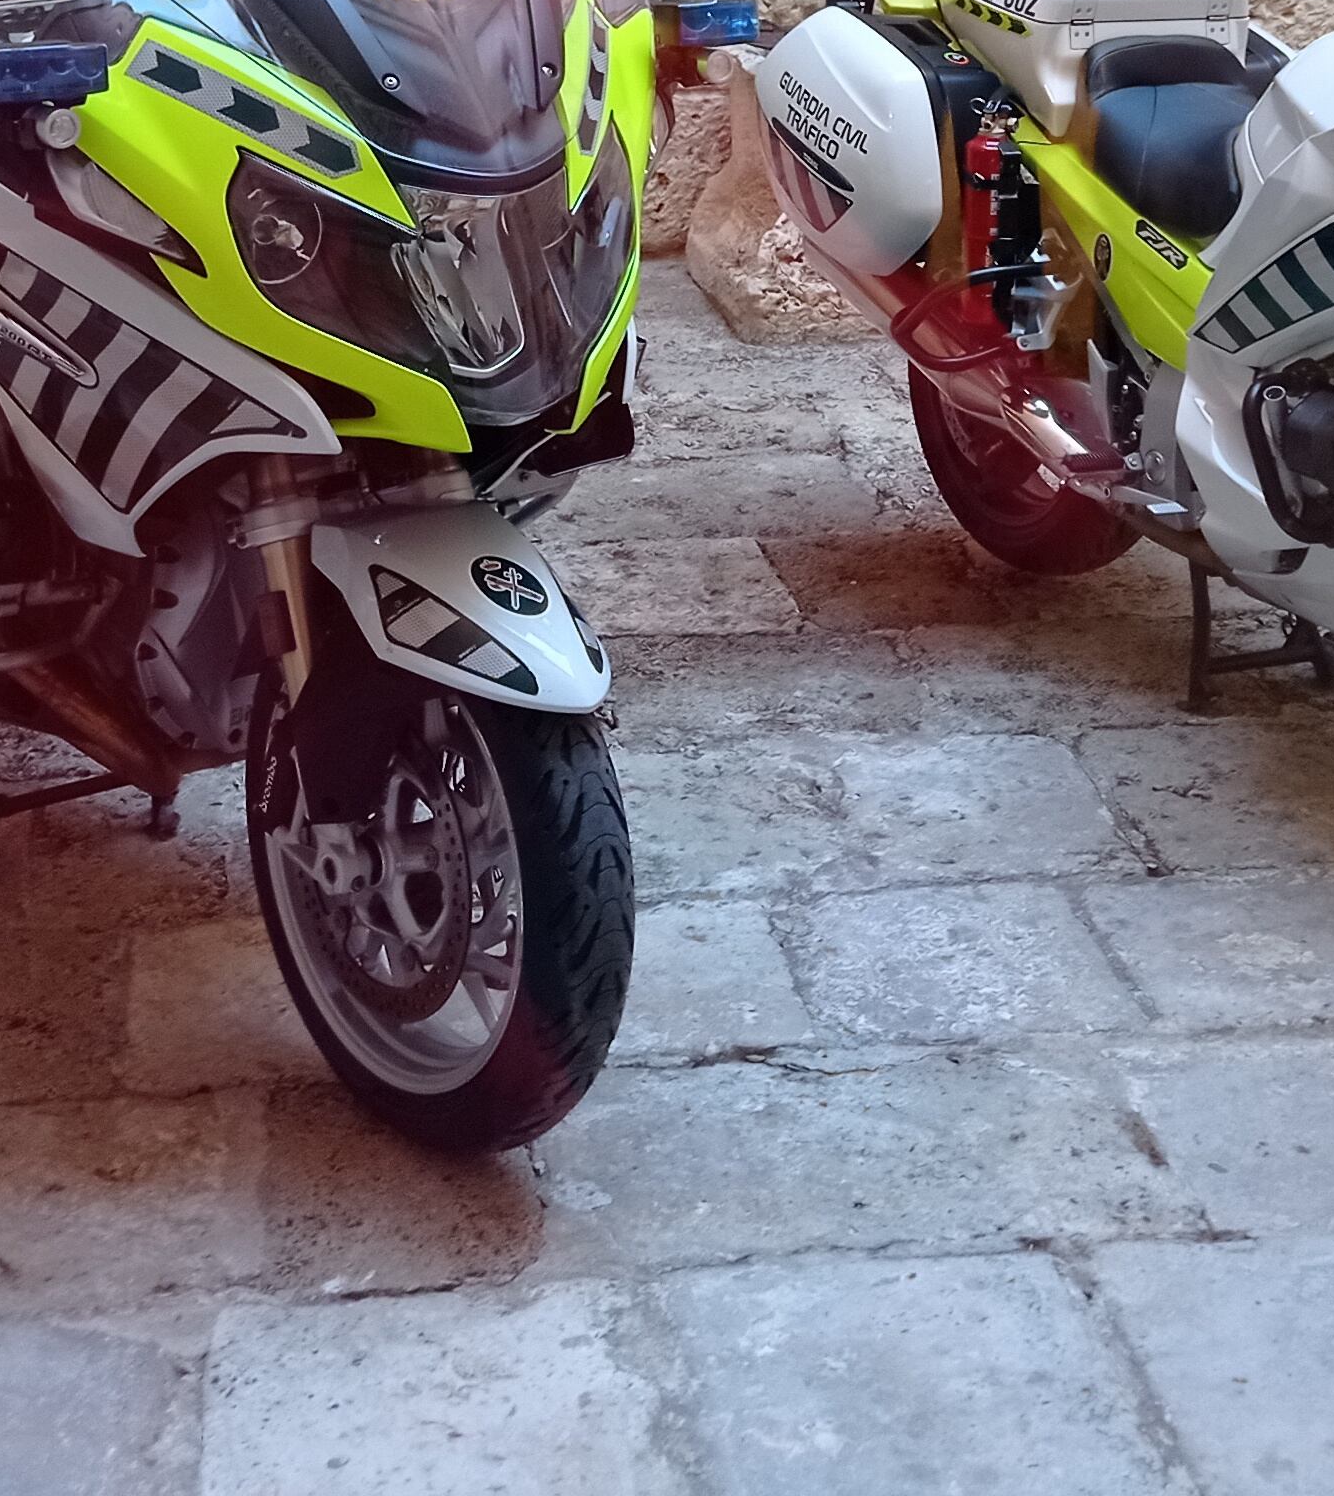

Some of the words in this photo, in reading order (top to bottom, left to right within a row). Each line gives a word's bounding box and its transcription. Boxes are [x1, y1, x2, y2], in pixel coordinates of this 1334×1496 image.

[779, 70, 830, 128] GUARDIA
[832, 116, 868, 155] CIVIL
[786, 103, 840, 160] TRÁFICO
[1137, 226, 1185, 267] FJR
[258, 755, 278, 814] brembo
